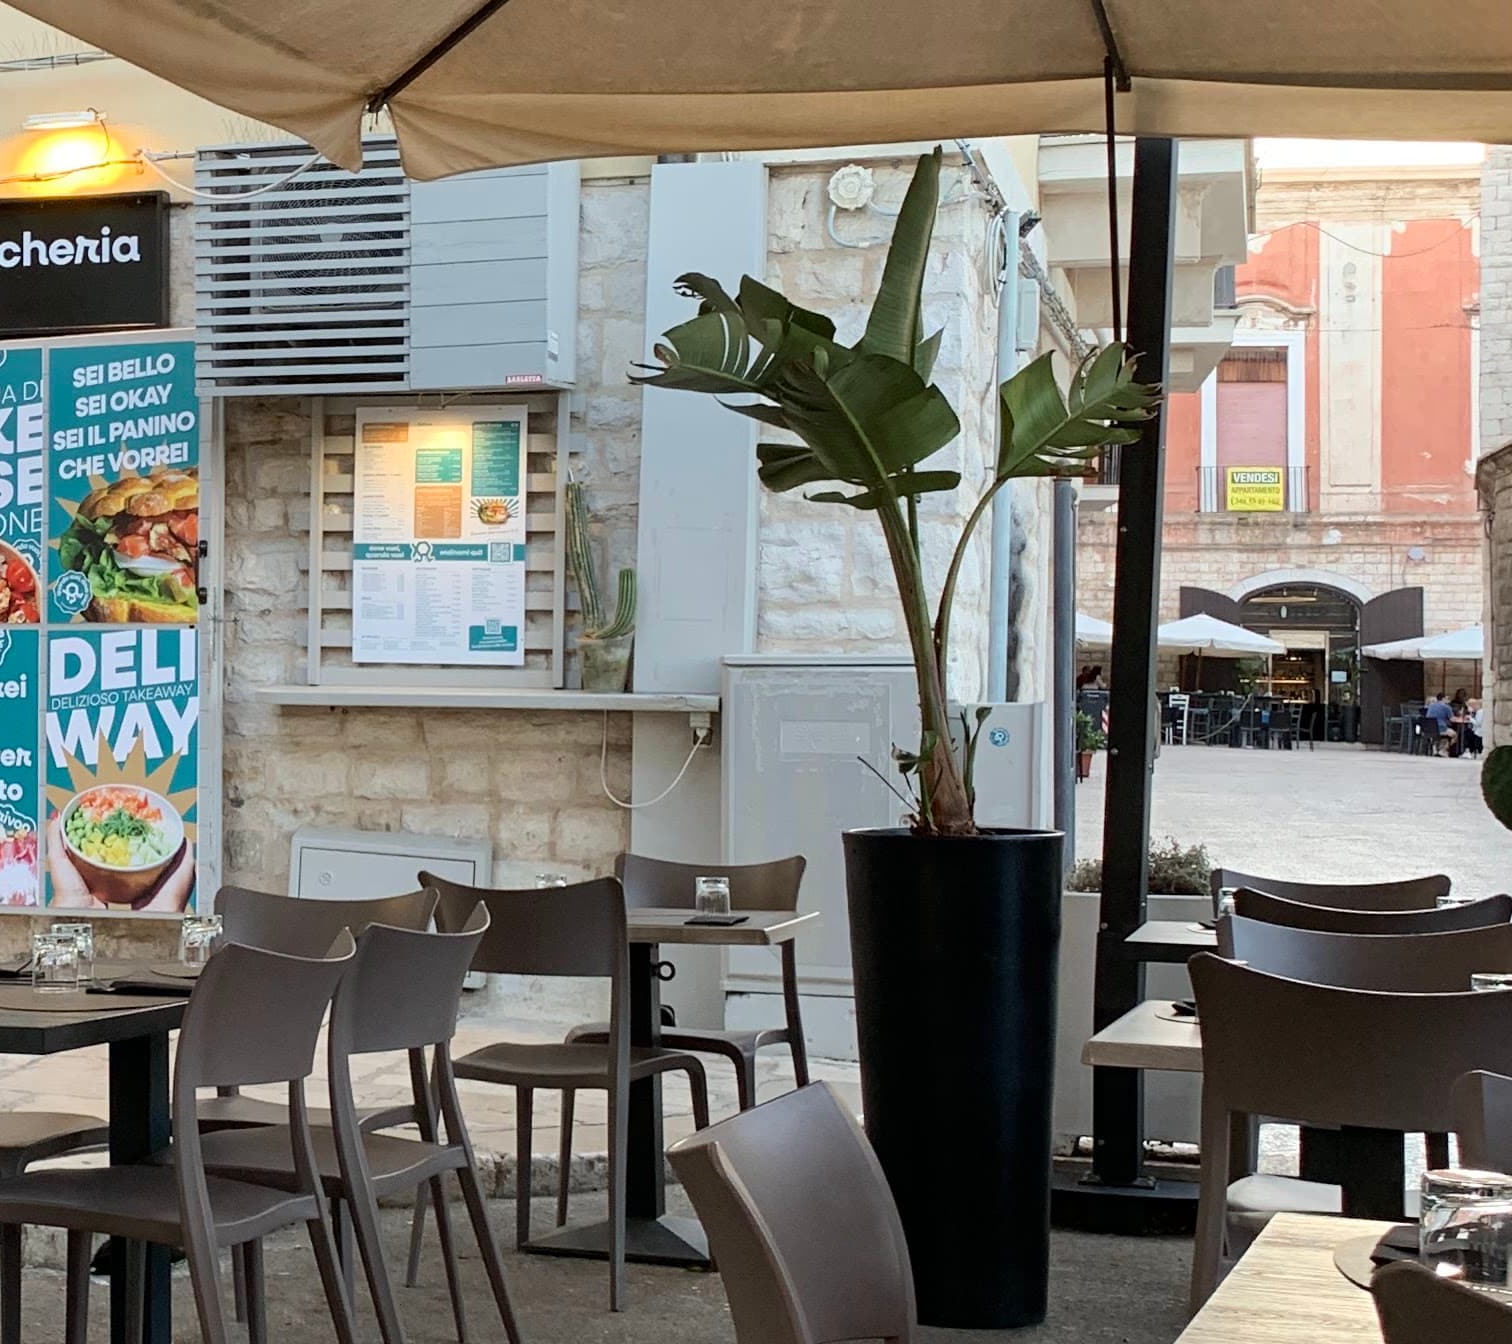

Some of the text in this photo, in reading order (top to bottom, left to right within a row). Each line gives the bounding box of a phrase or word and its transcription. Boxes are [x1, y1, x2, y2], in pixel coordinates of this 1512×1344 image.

[72, 353, 175, 388] SEI BELLO
[75, 383, 173, 418] SEI OKAY
[53, 411, 196, 451] SEI IL PANINO
[58, 442, 188, 480] CHE VORREI
[1233, 472, 1279, 483] VENDESI
[50, 629, 196, 696] DELI
[52, 683, 193, 710] DELIZIOSO TAKEAWAY
[46, 697, 200, 768] WAY
